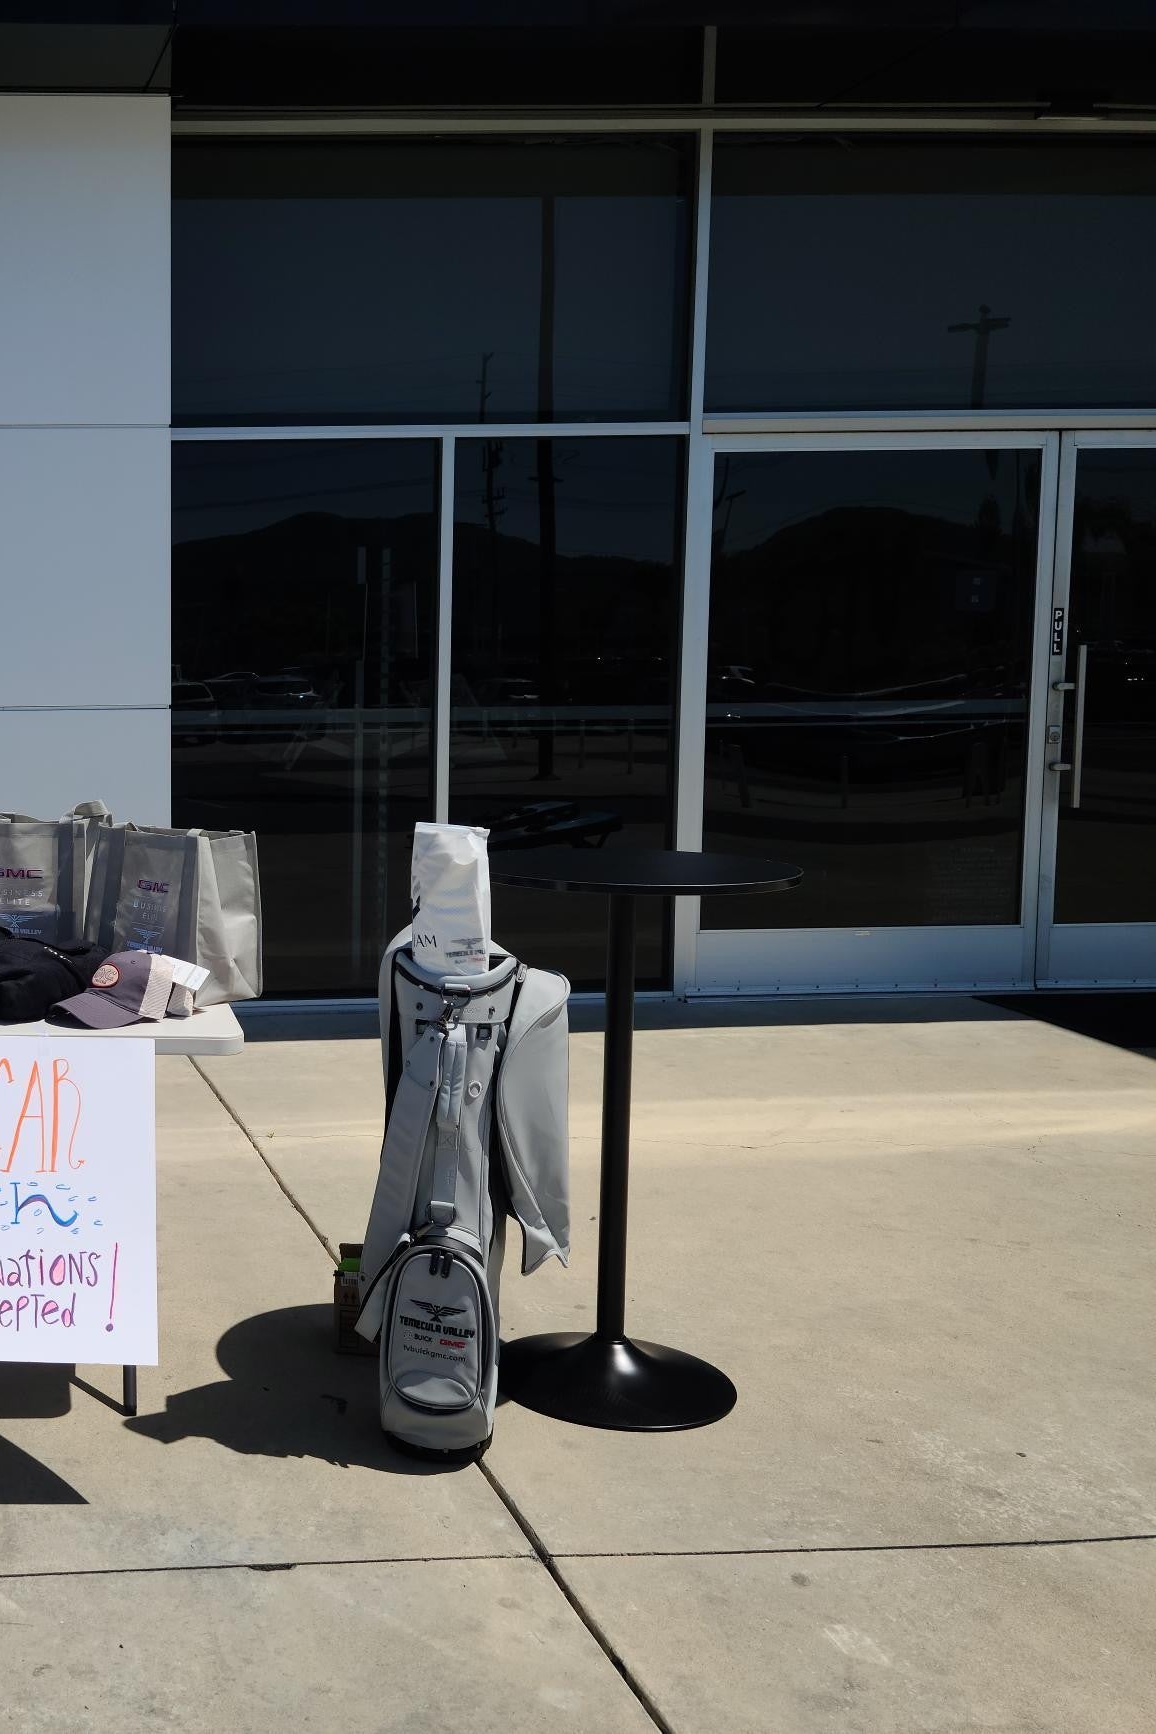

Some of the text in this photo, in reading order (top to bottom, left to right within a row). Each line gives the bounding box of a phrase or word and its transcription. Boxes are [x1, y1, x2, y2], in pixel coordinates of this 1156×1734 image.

[1053, 610, 1063, 653] PULL
[0, 898, 31, 906] ELITE
[399, 1315, 476, 1339] TEMECULA VALLEY
[414, 1333, 466, 1349] BUICK GMC
[403, 1344, 467, 1363] tvbuickgmc.com
